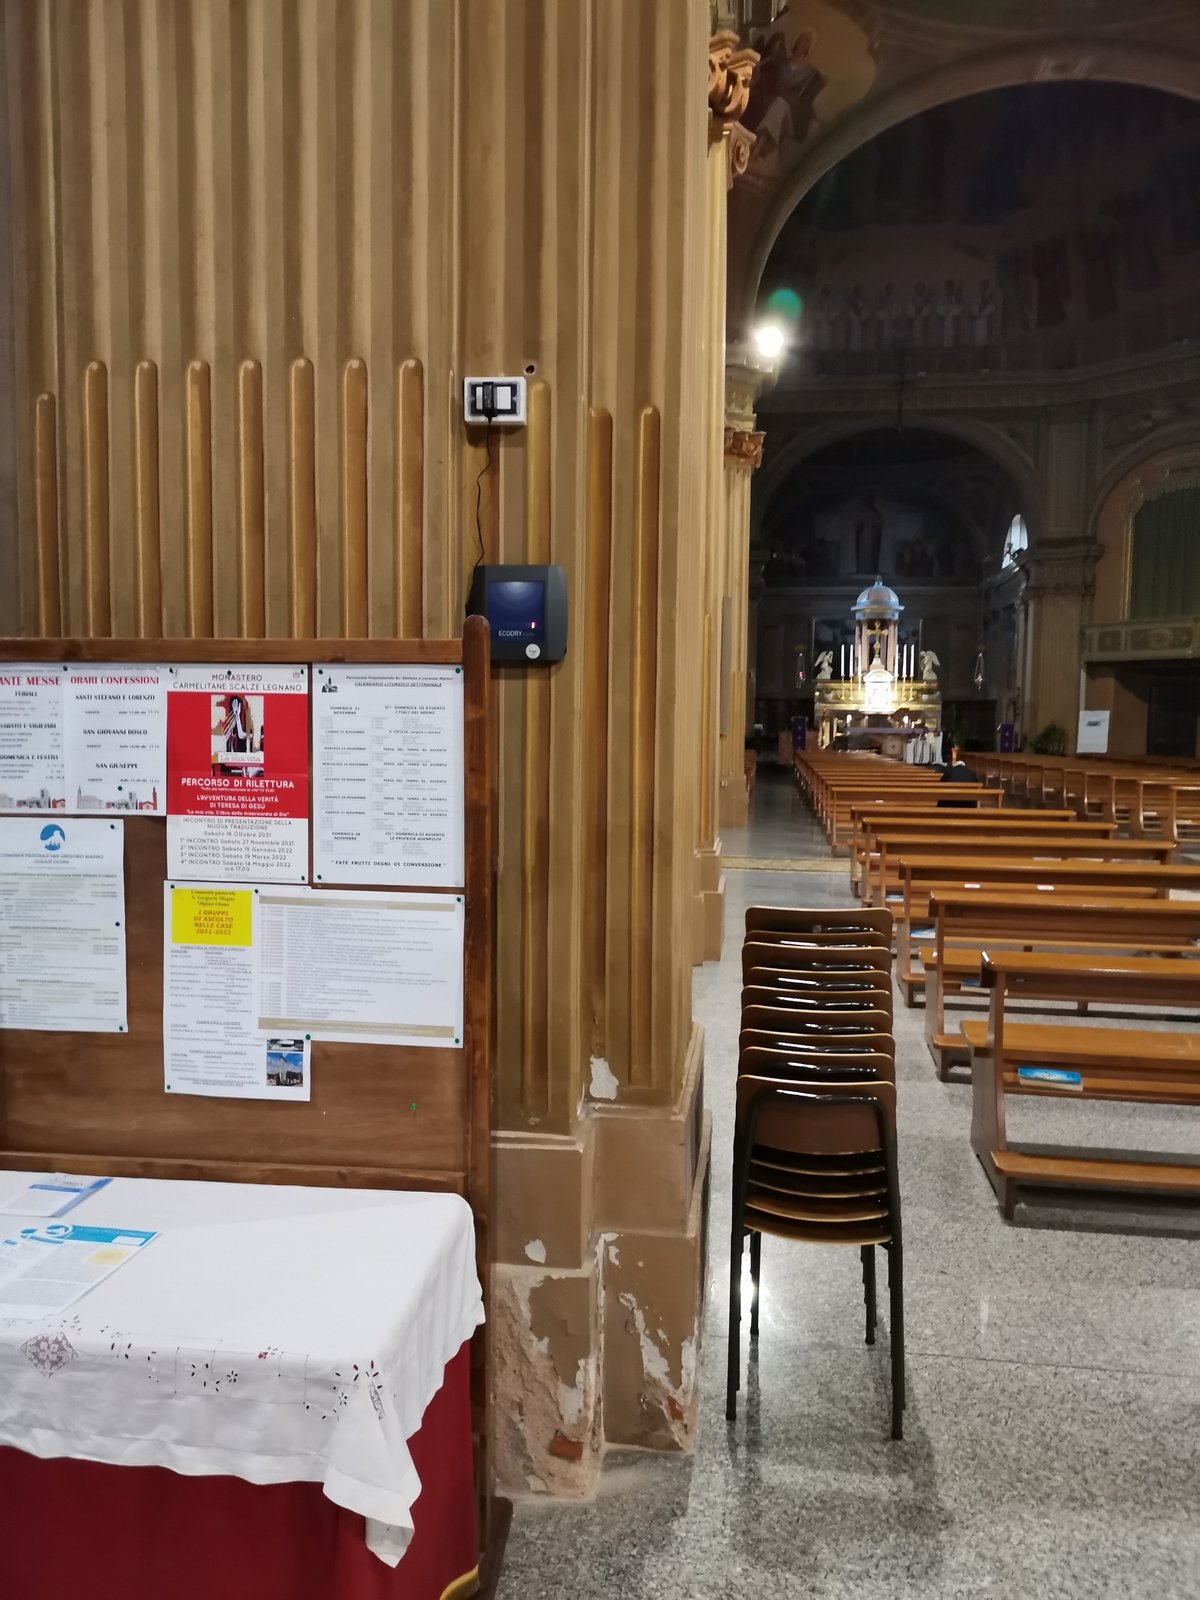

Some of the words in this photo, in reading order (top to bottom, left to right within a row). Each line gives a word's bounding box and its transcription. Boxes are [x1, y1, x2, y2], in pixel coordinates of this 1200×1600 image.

[26, 676, 61, 686] MESSE
[70, 676, 98, 684] ORARI
[100, 676, 160, 685] CONFESSIONI
[172, 682, 226, 690] CARMELITANE
[181, 778, 230, 787] PERCORSO
[234, 779, 243, 787] DI
[246, 780, 294, 789] RILETTURA
